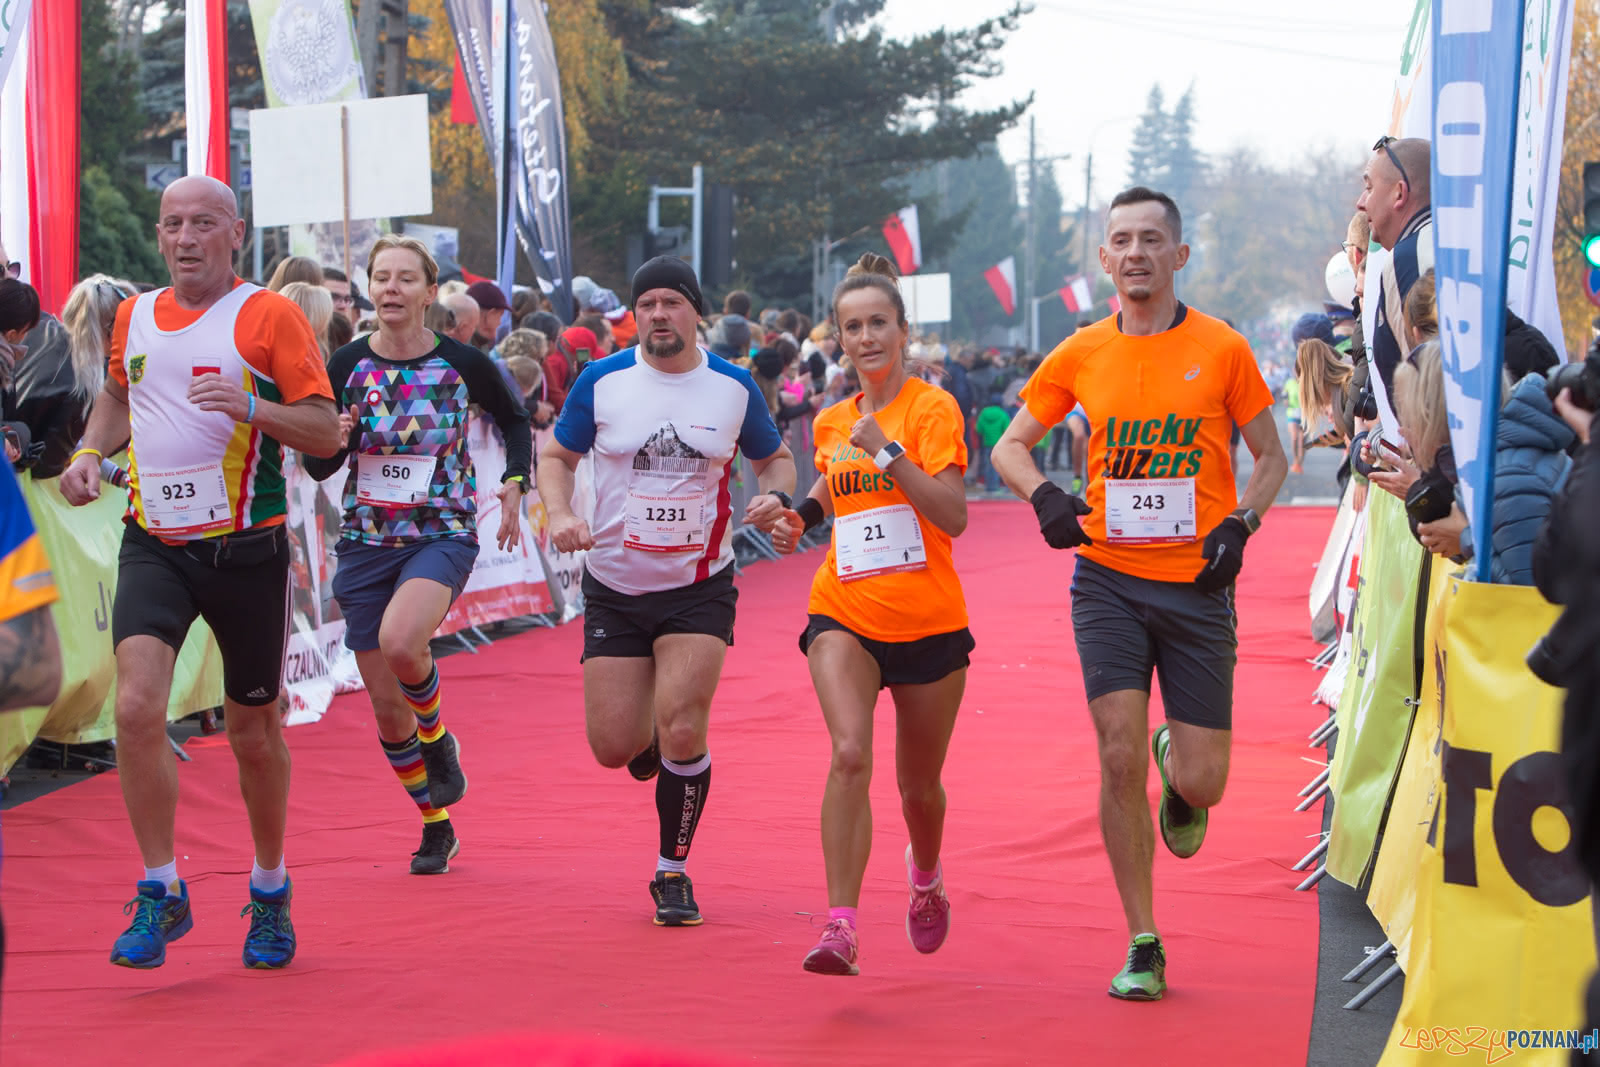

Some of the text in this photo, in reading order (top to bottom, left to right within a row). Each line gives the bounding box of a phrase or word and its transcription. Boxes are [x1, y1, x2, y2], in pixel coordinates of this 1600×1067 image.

[1106, 413, 1204, 448] Lucky
[832, 442, 873, 463] Luc
[382, 464, 410, 480] 650
[1101, 448, 1203, 479] LUZers
[162, 483, 196, 500] 923
[832, 470, 894, 497] LUZers
[1132, 494, 1165, 510] 243
[646, 508, 687, 522] 1231
[863, 523, 886, 541] 21
